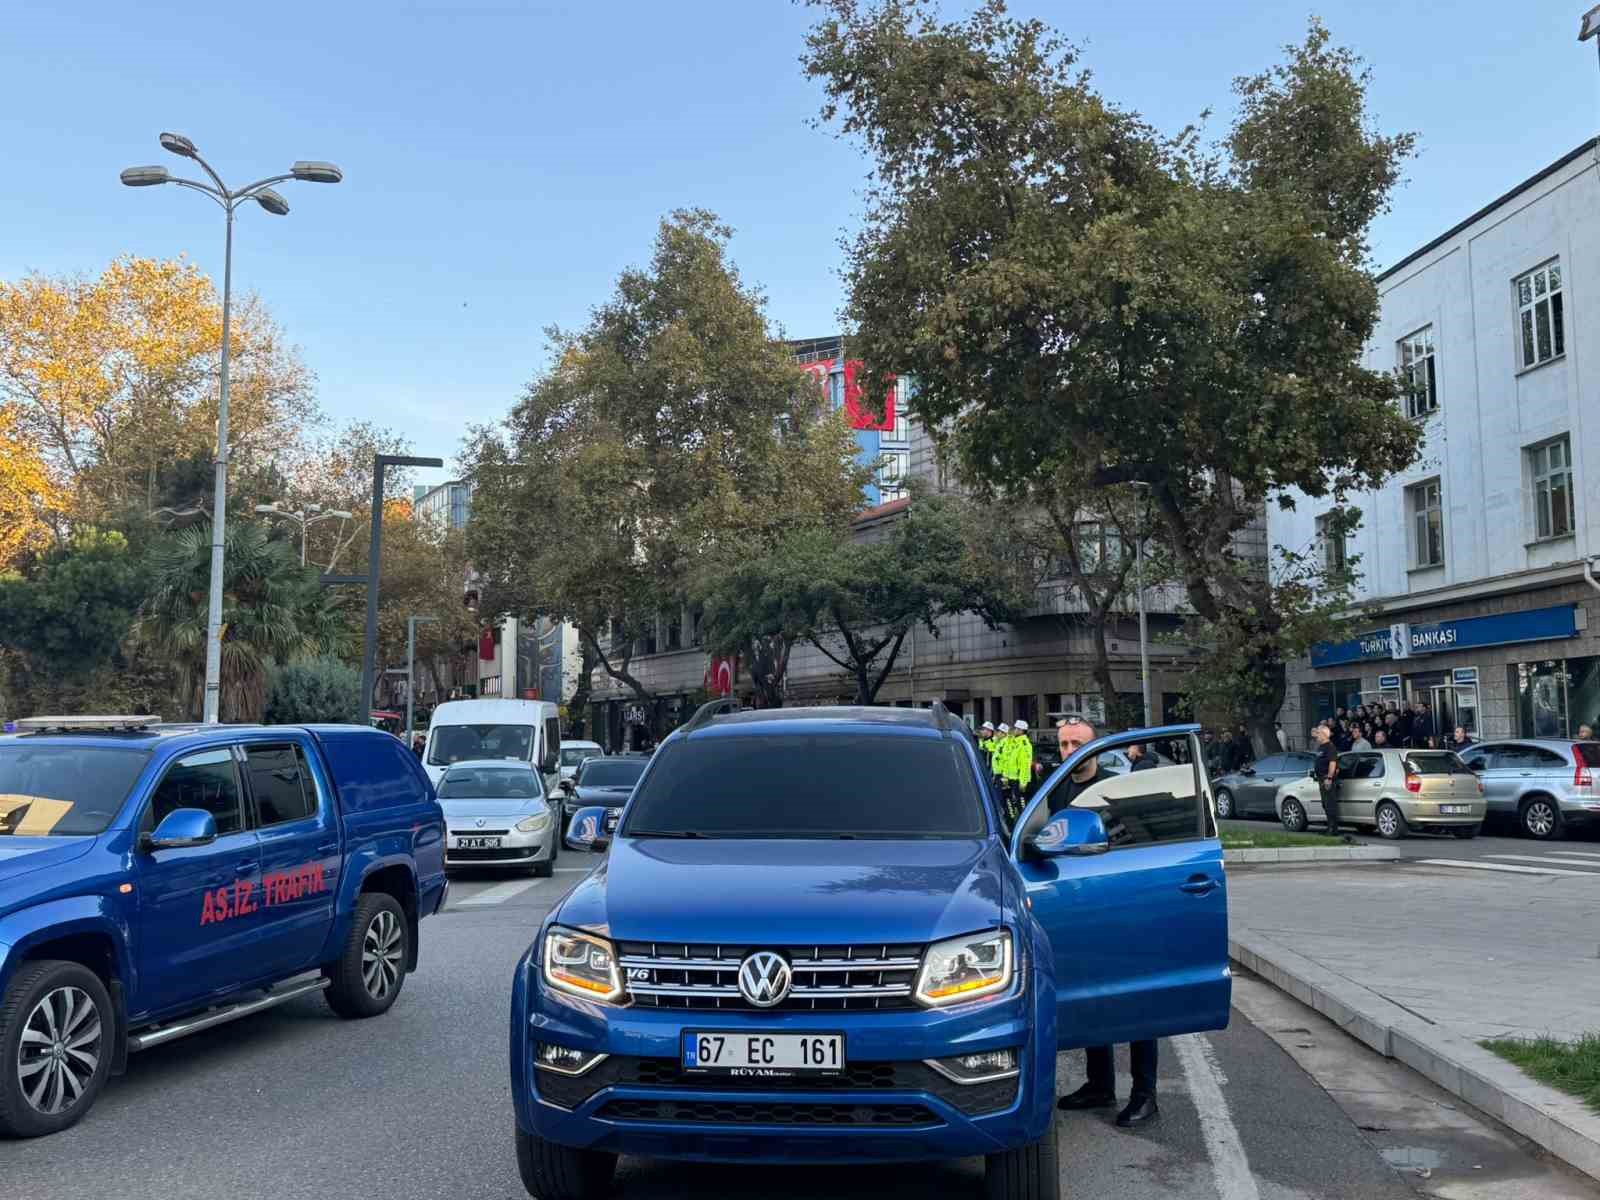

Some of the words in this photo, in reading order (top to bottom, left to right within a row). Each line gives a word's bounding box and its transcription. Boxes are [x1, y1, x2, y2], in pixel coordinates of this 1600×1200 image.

[1412, 629, 1457, 647] BANKASI
[626, 968, 649, 980] V6
[699, 1037, 725, 1063] 67
[747, 1038, 774, 1064] EC
[801, 1038, 836, 1065] 161
